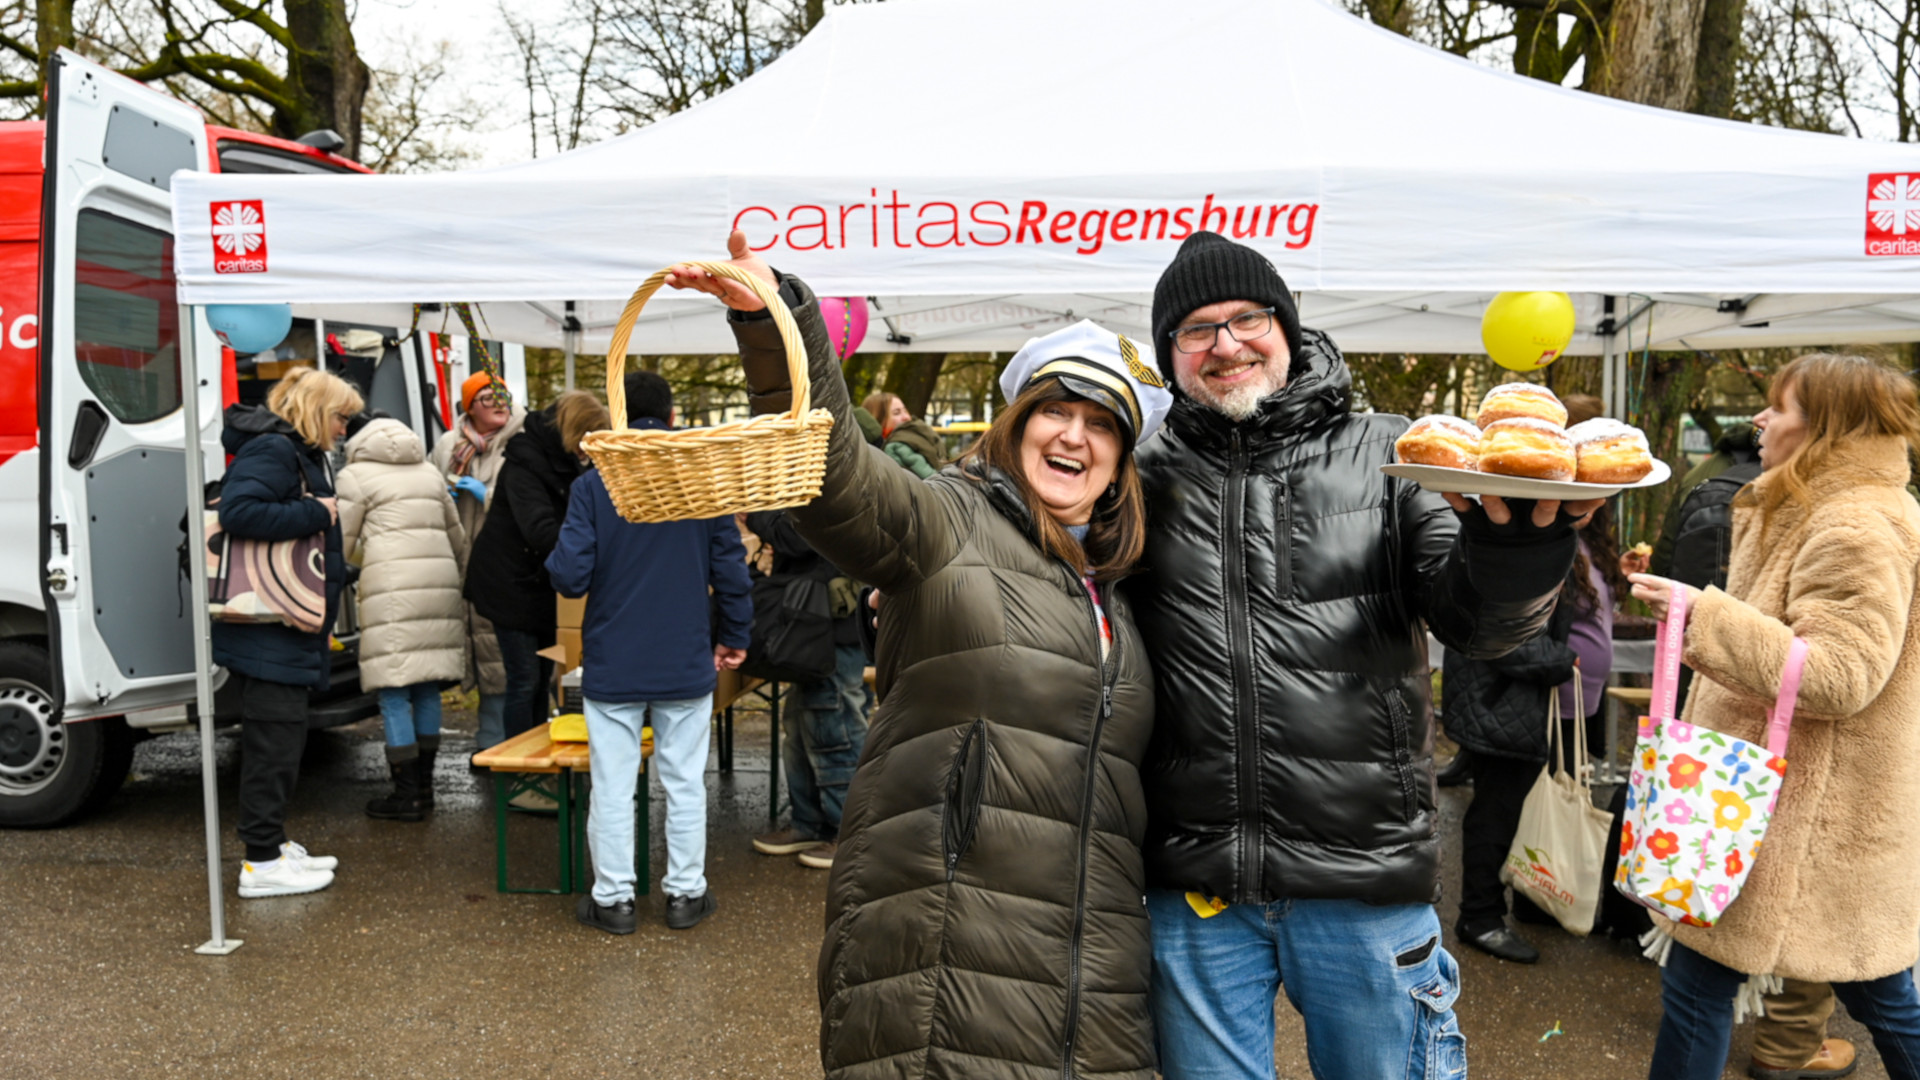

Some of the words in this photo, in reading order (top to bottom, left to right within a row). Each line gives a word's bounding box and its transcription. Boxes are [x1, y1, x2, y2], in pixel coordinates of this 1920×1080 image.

[216, 257, 265, 273] caritas
[1668, 618, 1681, 649] GOOD
[1665, 652, 1677, 681] TIME!
